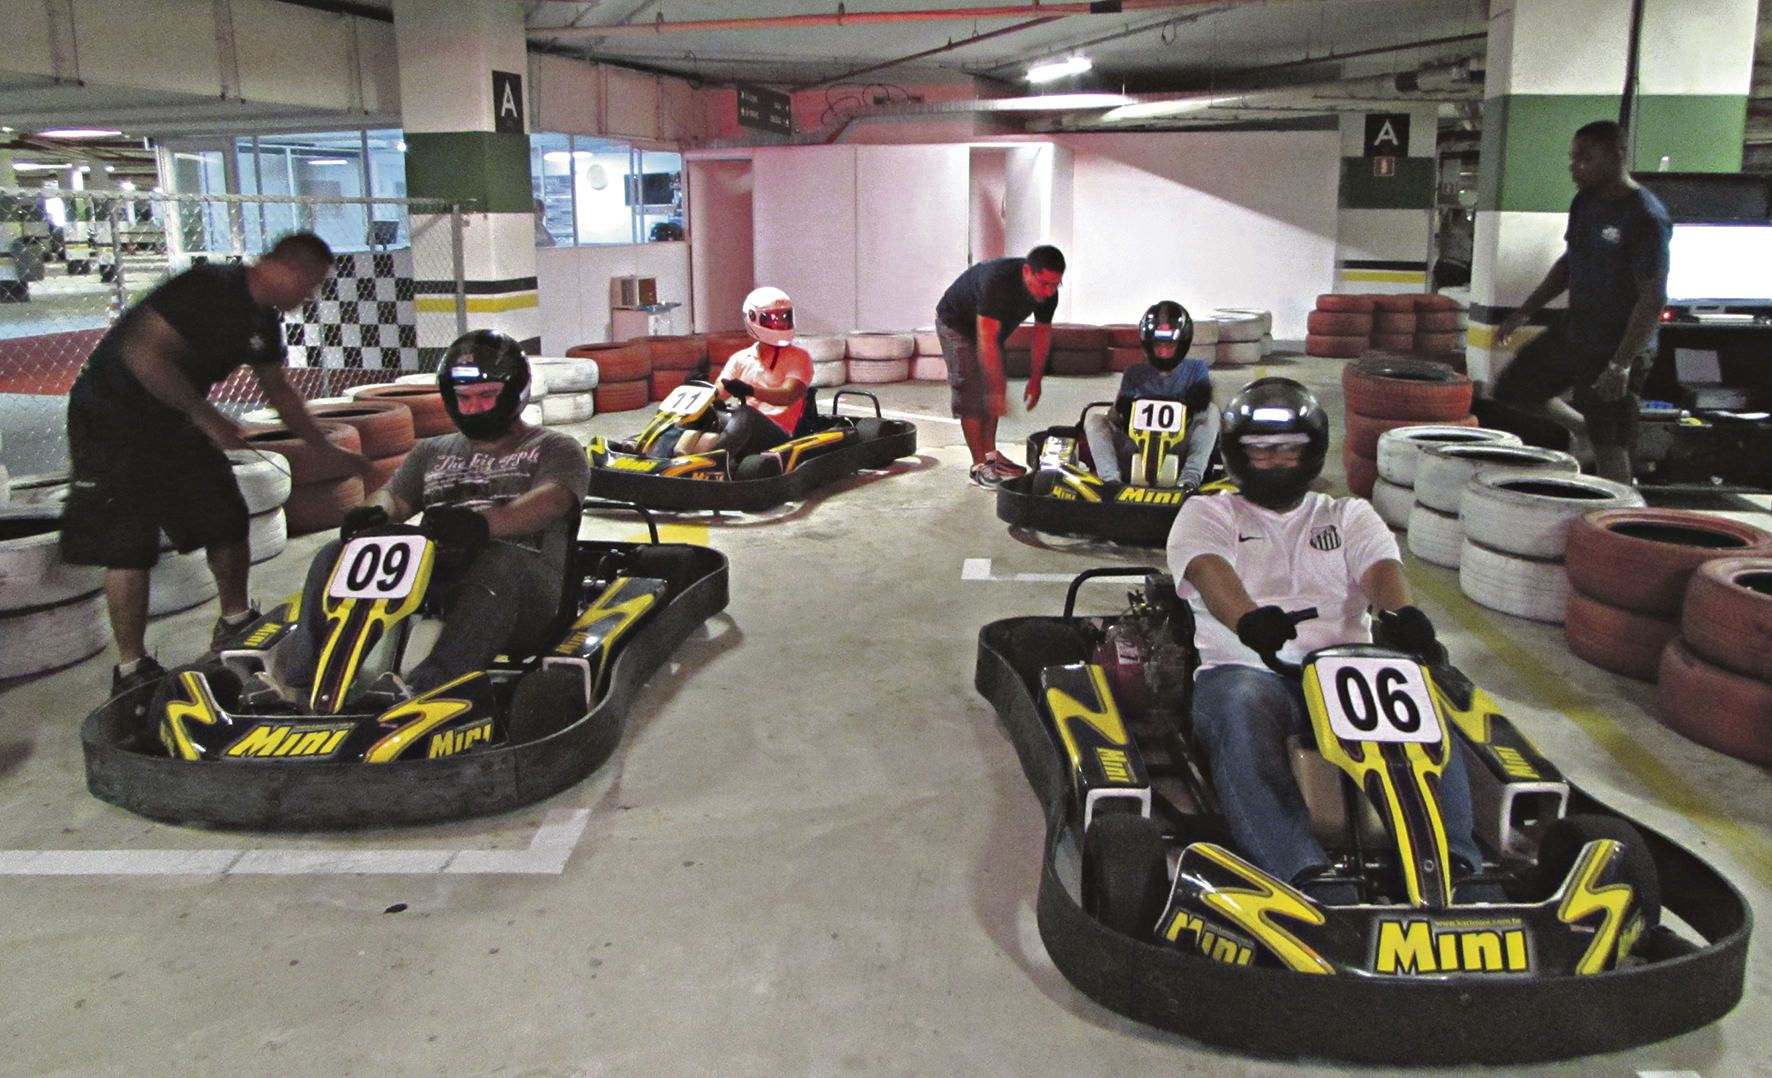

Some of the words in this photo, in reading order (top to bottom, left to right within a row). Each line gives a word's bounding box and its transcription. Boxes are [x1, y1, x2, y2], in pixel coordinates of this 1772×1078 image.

[501, 80, 518, 118] A
[1374, 119, 1399, 146] A
[671, 391, 703, 411] 11
[1142, 403, 1175, 429] 10
[1118, 487, 1183, 505] Mini
[346, 542, 411, 592] 09
[1335, 666, 1421, 733] 06
[226, 726, 348, 756] Mini
[1376, 921, 1528, 972] Mini
